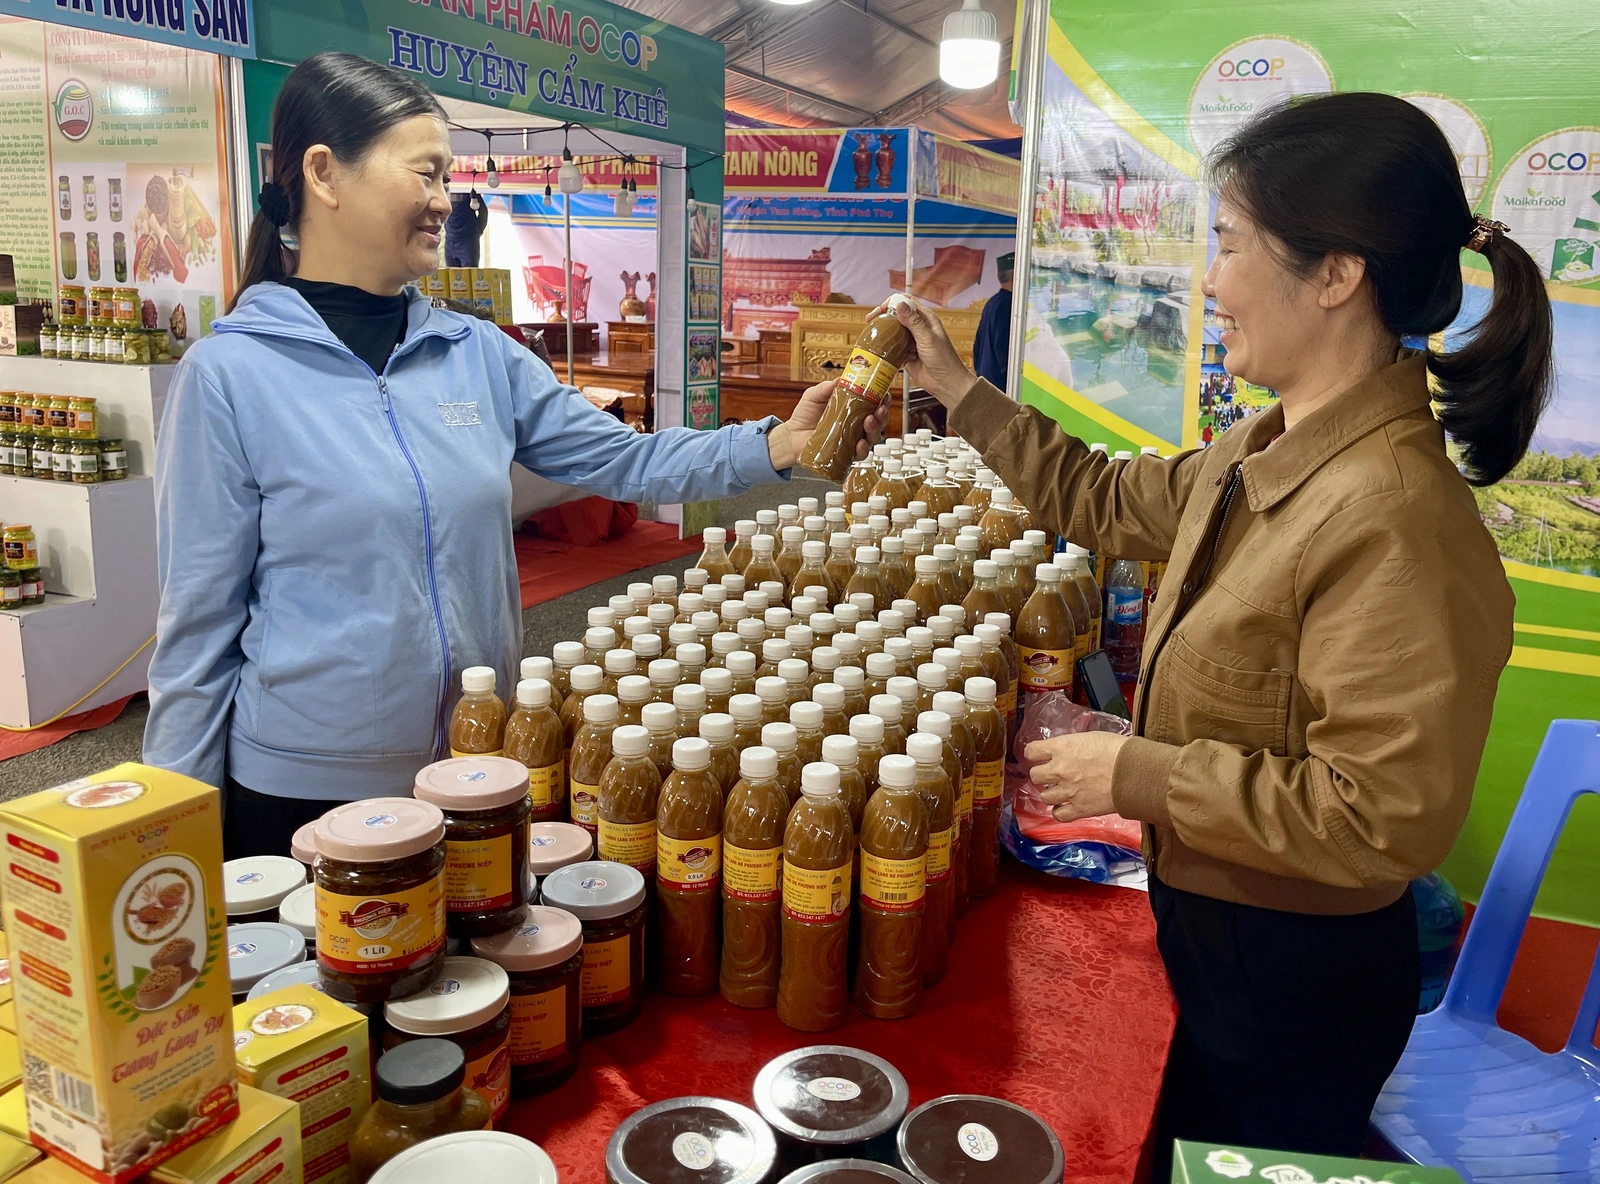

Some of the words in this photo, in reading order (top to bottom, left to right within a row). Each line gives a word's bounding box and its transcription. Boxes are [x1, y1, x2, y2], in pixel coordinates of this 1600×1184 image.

[577, 15, 658, 72] OCOP
[387, 26, 529, 100] HUYỆN
[538, 53, 605, 114] CẨM
[612, 88, 668, 129] KHÊ
[1218, 58, 1285, 78] OCOP
[64, 106, 85, 116] G.O.C
[1199, 101, 1254, 113] MaikaFood
[724, 152, 758, 176] TAM
[764, 146, 818, 177] NÔNG
[1528, 152, 1600, 171] OCOP
[1504, 196, 1566, 206] MaikaFood
[771, 206, 790, 215] Tam
[826, 206, 848, 216] Tỉnh
[851, 206, 871, 216] Phú
[874, 207, 894, 219] Thọ
[137, 825, 169, 844] OCOP
[450, 862, 476, 870] PHƯỢNG
[478, 860, 492, 868] HIỆP
[450, 900, 492, 908] 033.547.1477
[352, 912, 378, 926] PHƯỢNG
[378, 906, 392, 918] HIỆP
[329, 934, 350, 944] OCOP
[372, 946, 385, 955] Lít
[136, 1020, 168, 1048] Đặc
[170, 1004, 200, 1030] Sản
[112, 1050, 159, 1084] Tương
[162, 1028, 200, 1060] Làng
[204, 1012, 226, 1036] Bợ
[818, 1081, 852, 1091] OCOP
[204, 1100, 218, 1114] 500
[219, 1094, 230, 1104] ml
[690, 1138, 710, 1162] OCOP
[965, 1129, 980, 1154] OCOP
